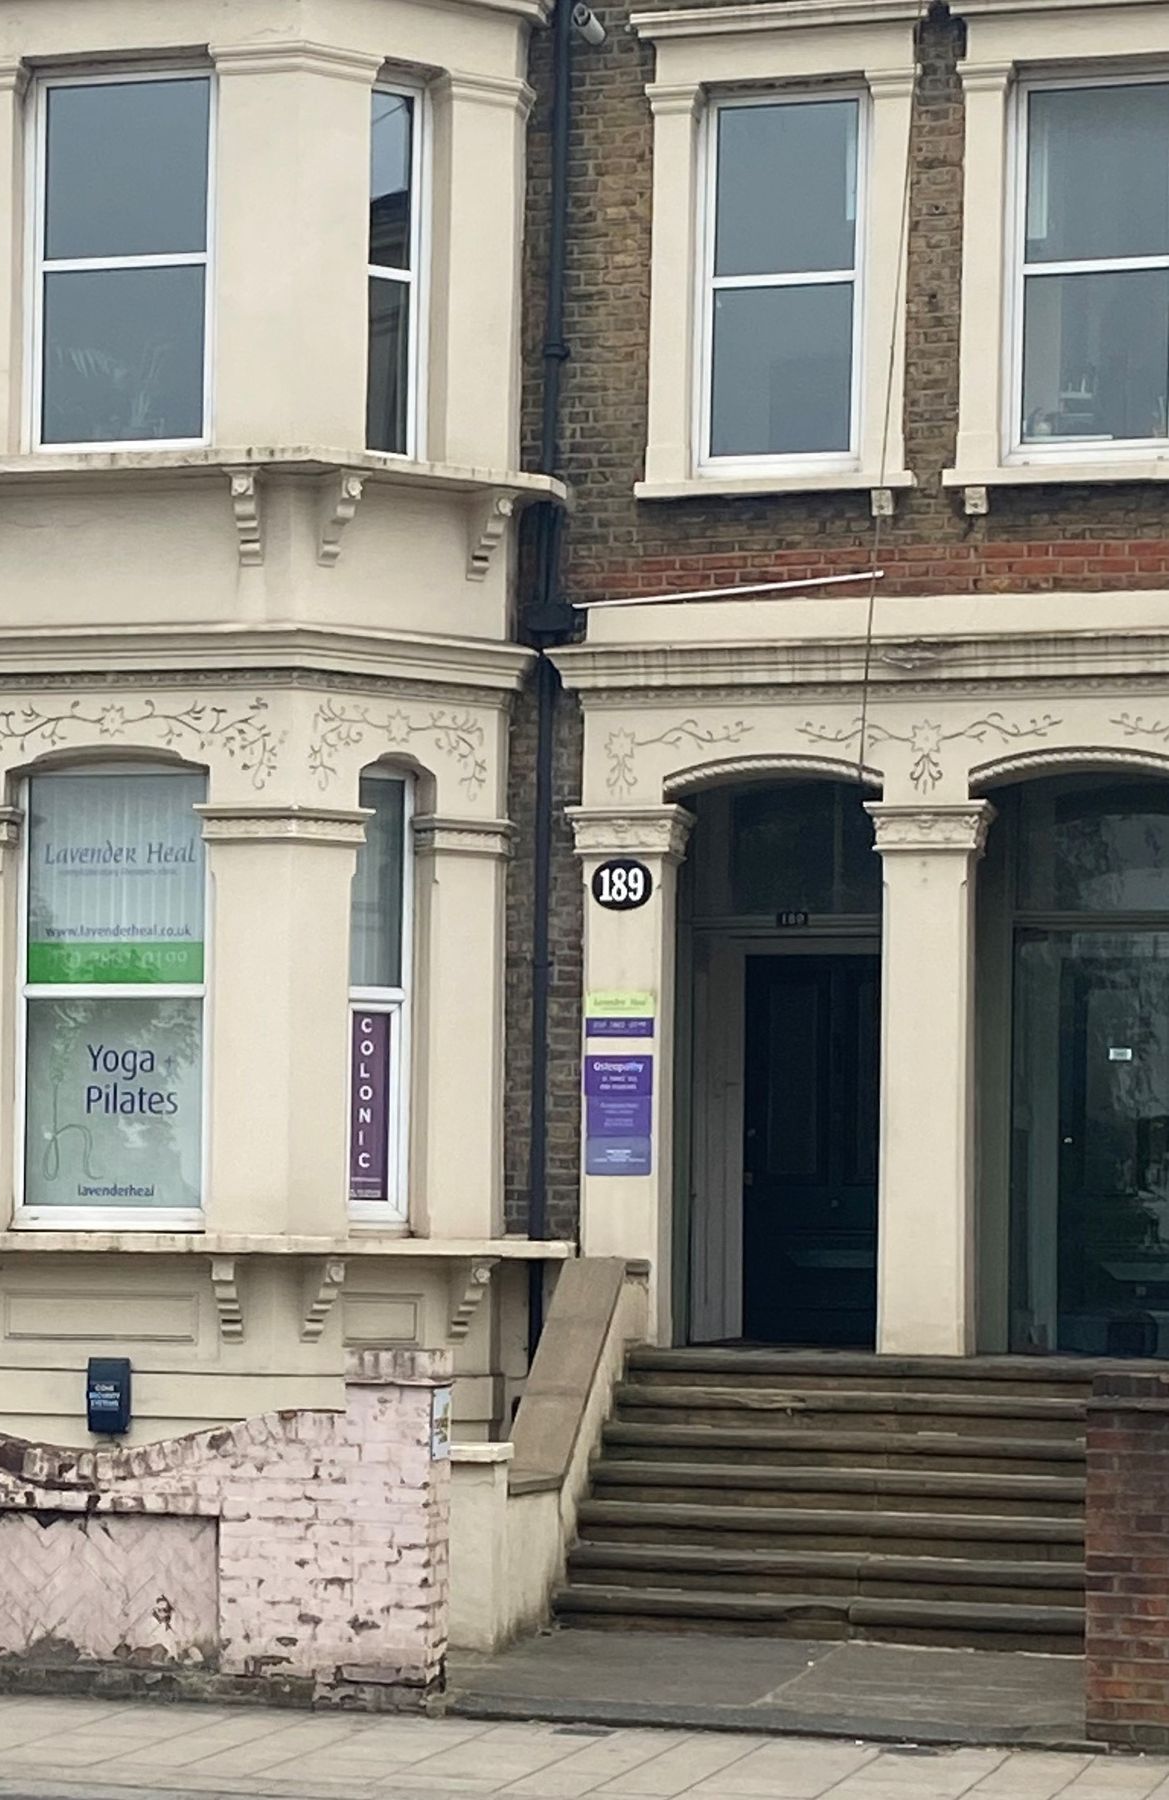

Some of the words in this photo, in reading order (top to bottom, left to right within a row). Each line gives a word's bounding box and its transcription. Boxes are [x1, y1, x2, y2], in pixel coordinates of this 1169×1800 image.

[599, 867, 644, 902] 189
[87, 1044, 155, 1081] Yoga
[86, 1083, 178, 1115] Pilates
[358, 1018, 374, 1168] COLONIC
[77, 1184, 155, 1197] lavenderheal
